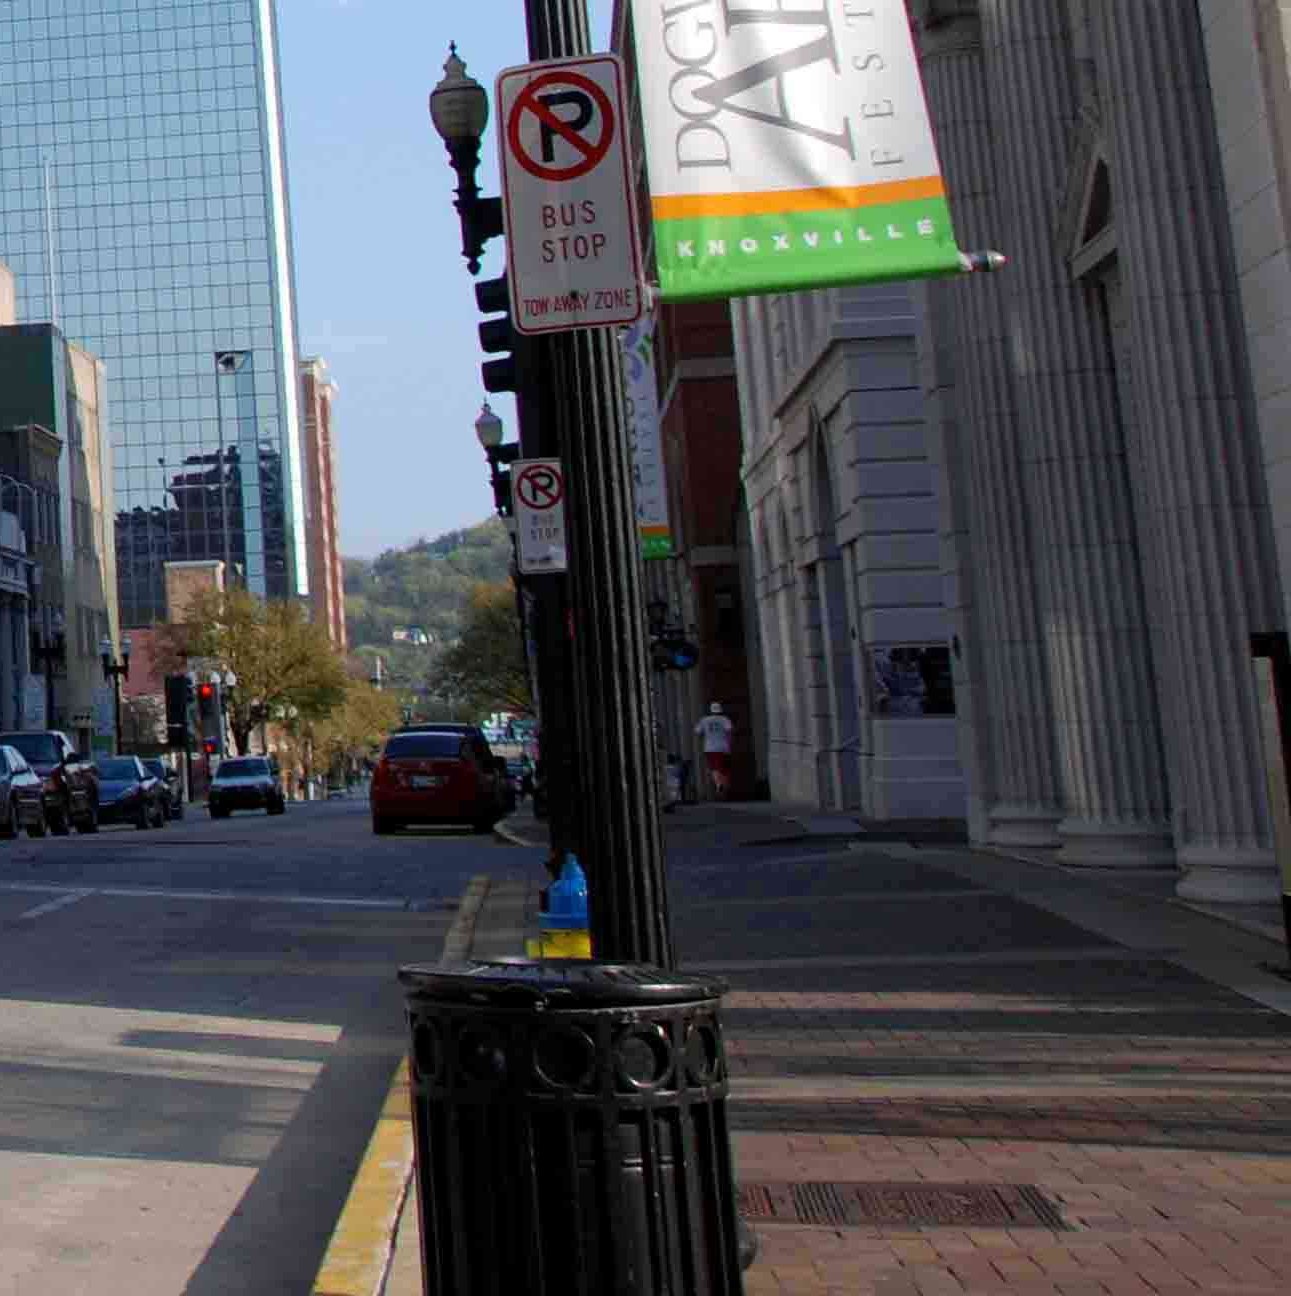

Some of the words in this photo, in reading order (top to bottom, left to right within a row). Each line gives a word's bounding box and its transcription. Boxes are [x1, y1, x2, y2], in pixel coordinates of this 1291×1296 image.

[542, 200, 596, 228] BUS
[542, 233, 606, 263] STOP
[677, 219, 935, 258] KNOXVILLE
[594, 289, 632, 310] ZONE
